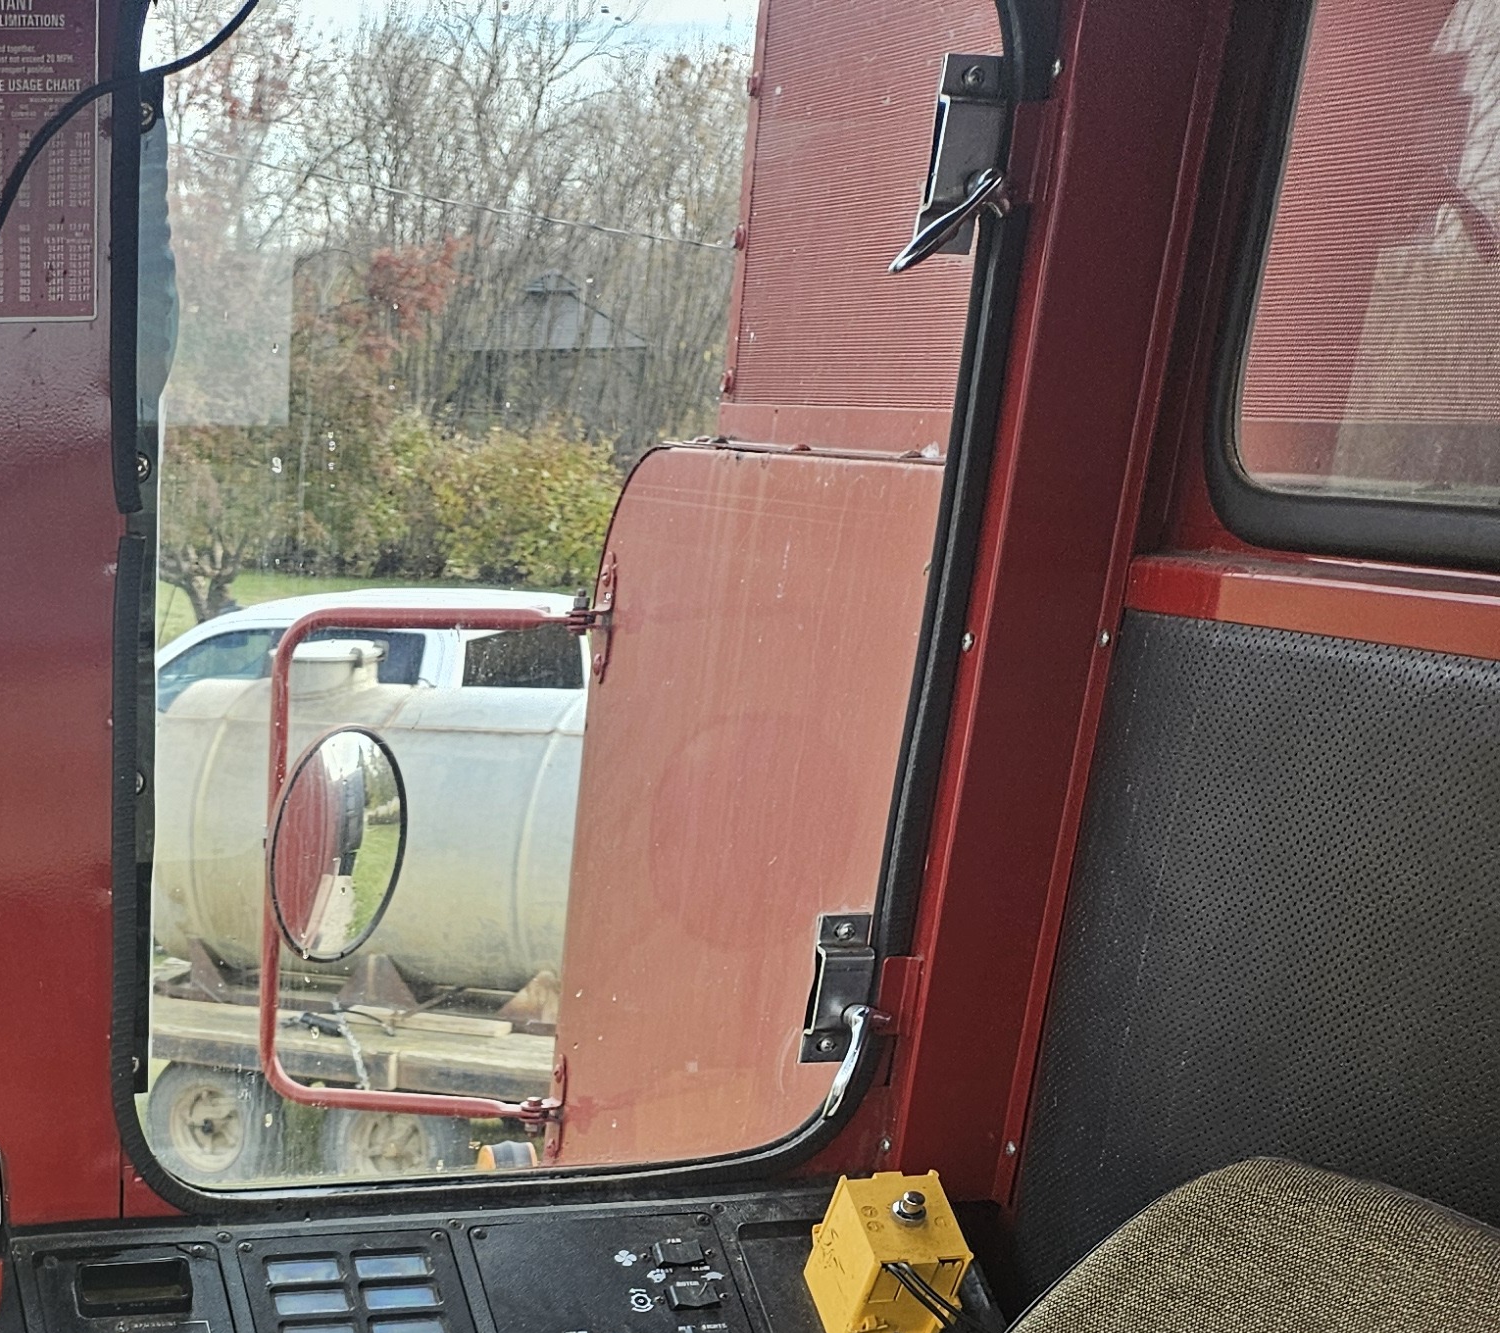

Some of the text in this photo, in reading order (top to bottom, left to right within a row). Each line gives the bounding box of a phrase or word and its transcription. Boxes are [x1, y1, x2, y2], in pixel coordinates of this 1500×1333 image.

[0, 14, 65, 27] LIMITATIONS
[8, 79, 42, 91] USAGE
[46, 79, 81, 91] CHART
